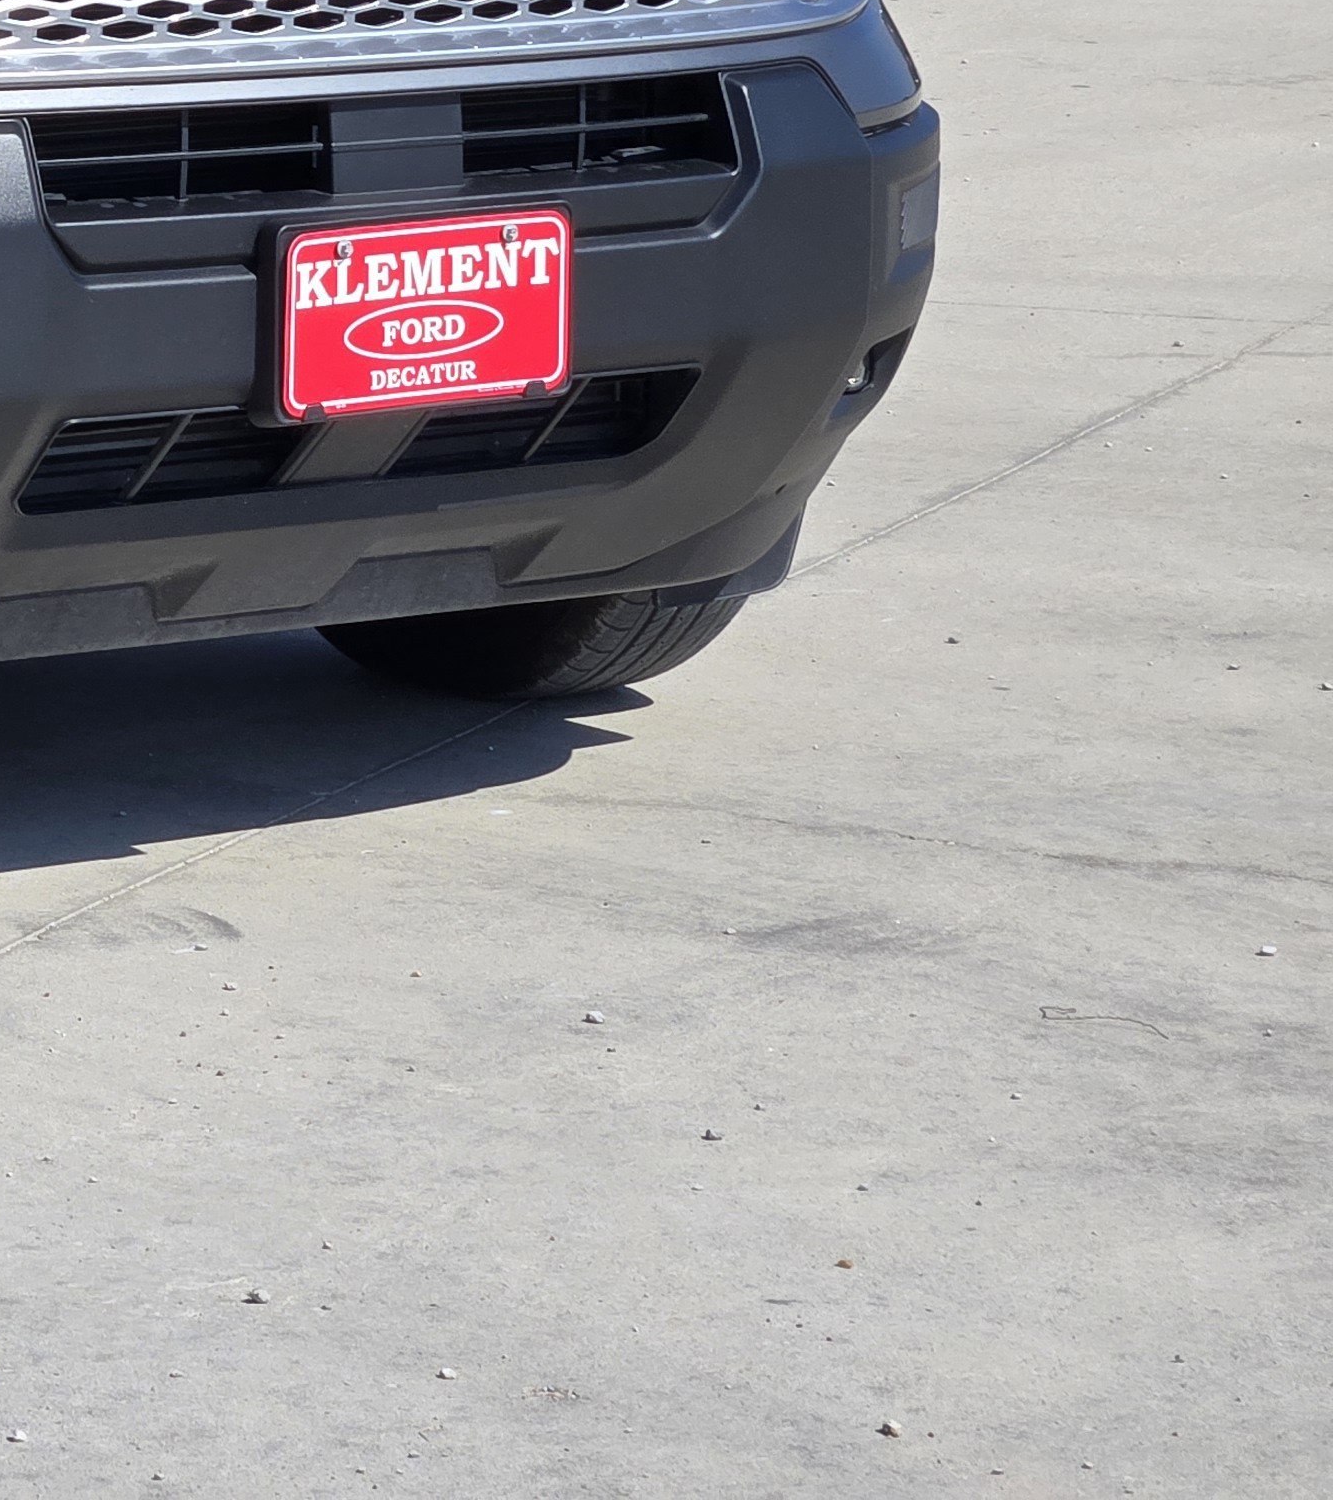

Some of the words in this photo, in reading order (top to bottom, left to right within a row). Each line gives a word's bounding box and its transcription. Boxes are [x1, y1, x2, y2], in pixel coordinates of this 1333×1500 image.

[295, 237, 560, 310] KLEMENT
[382, 314, 466, 348] FORD
[370, 360, 478, 391] DECATUR
